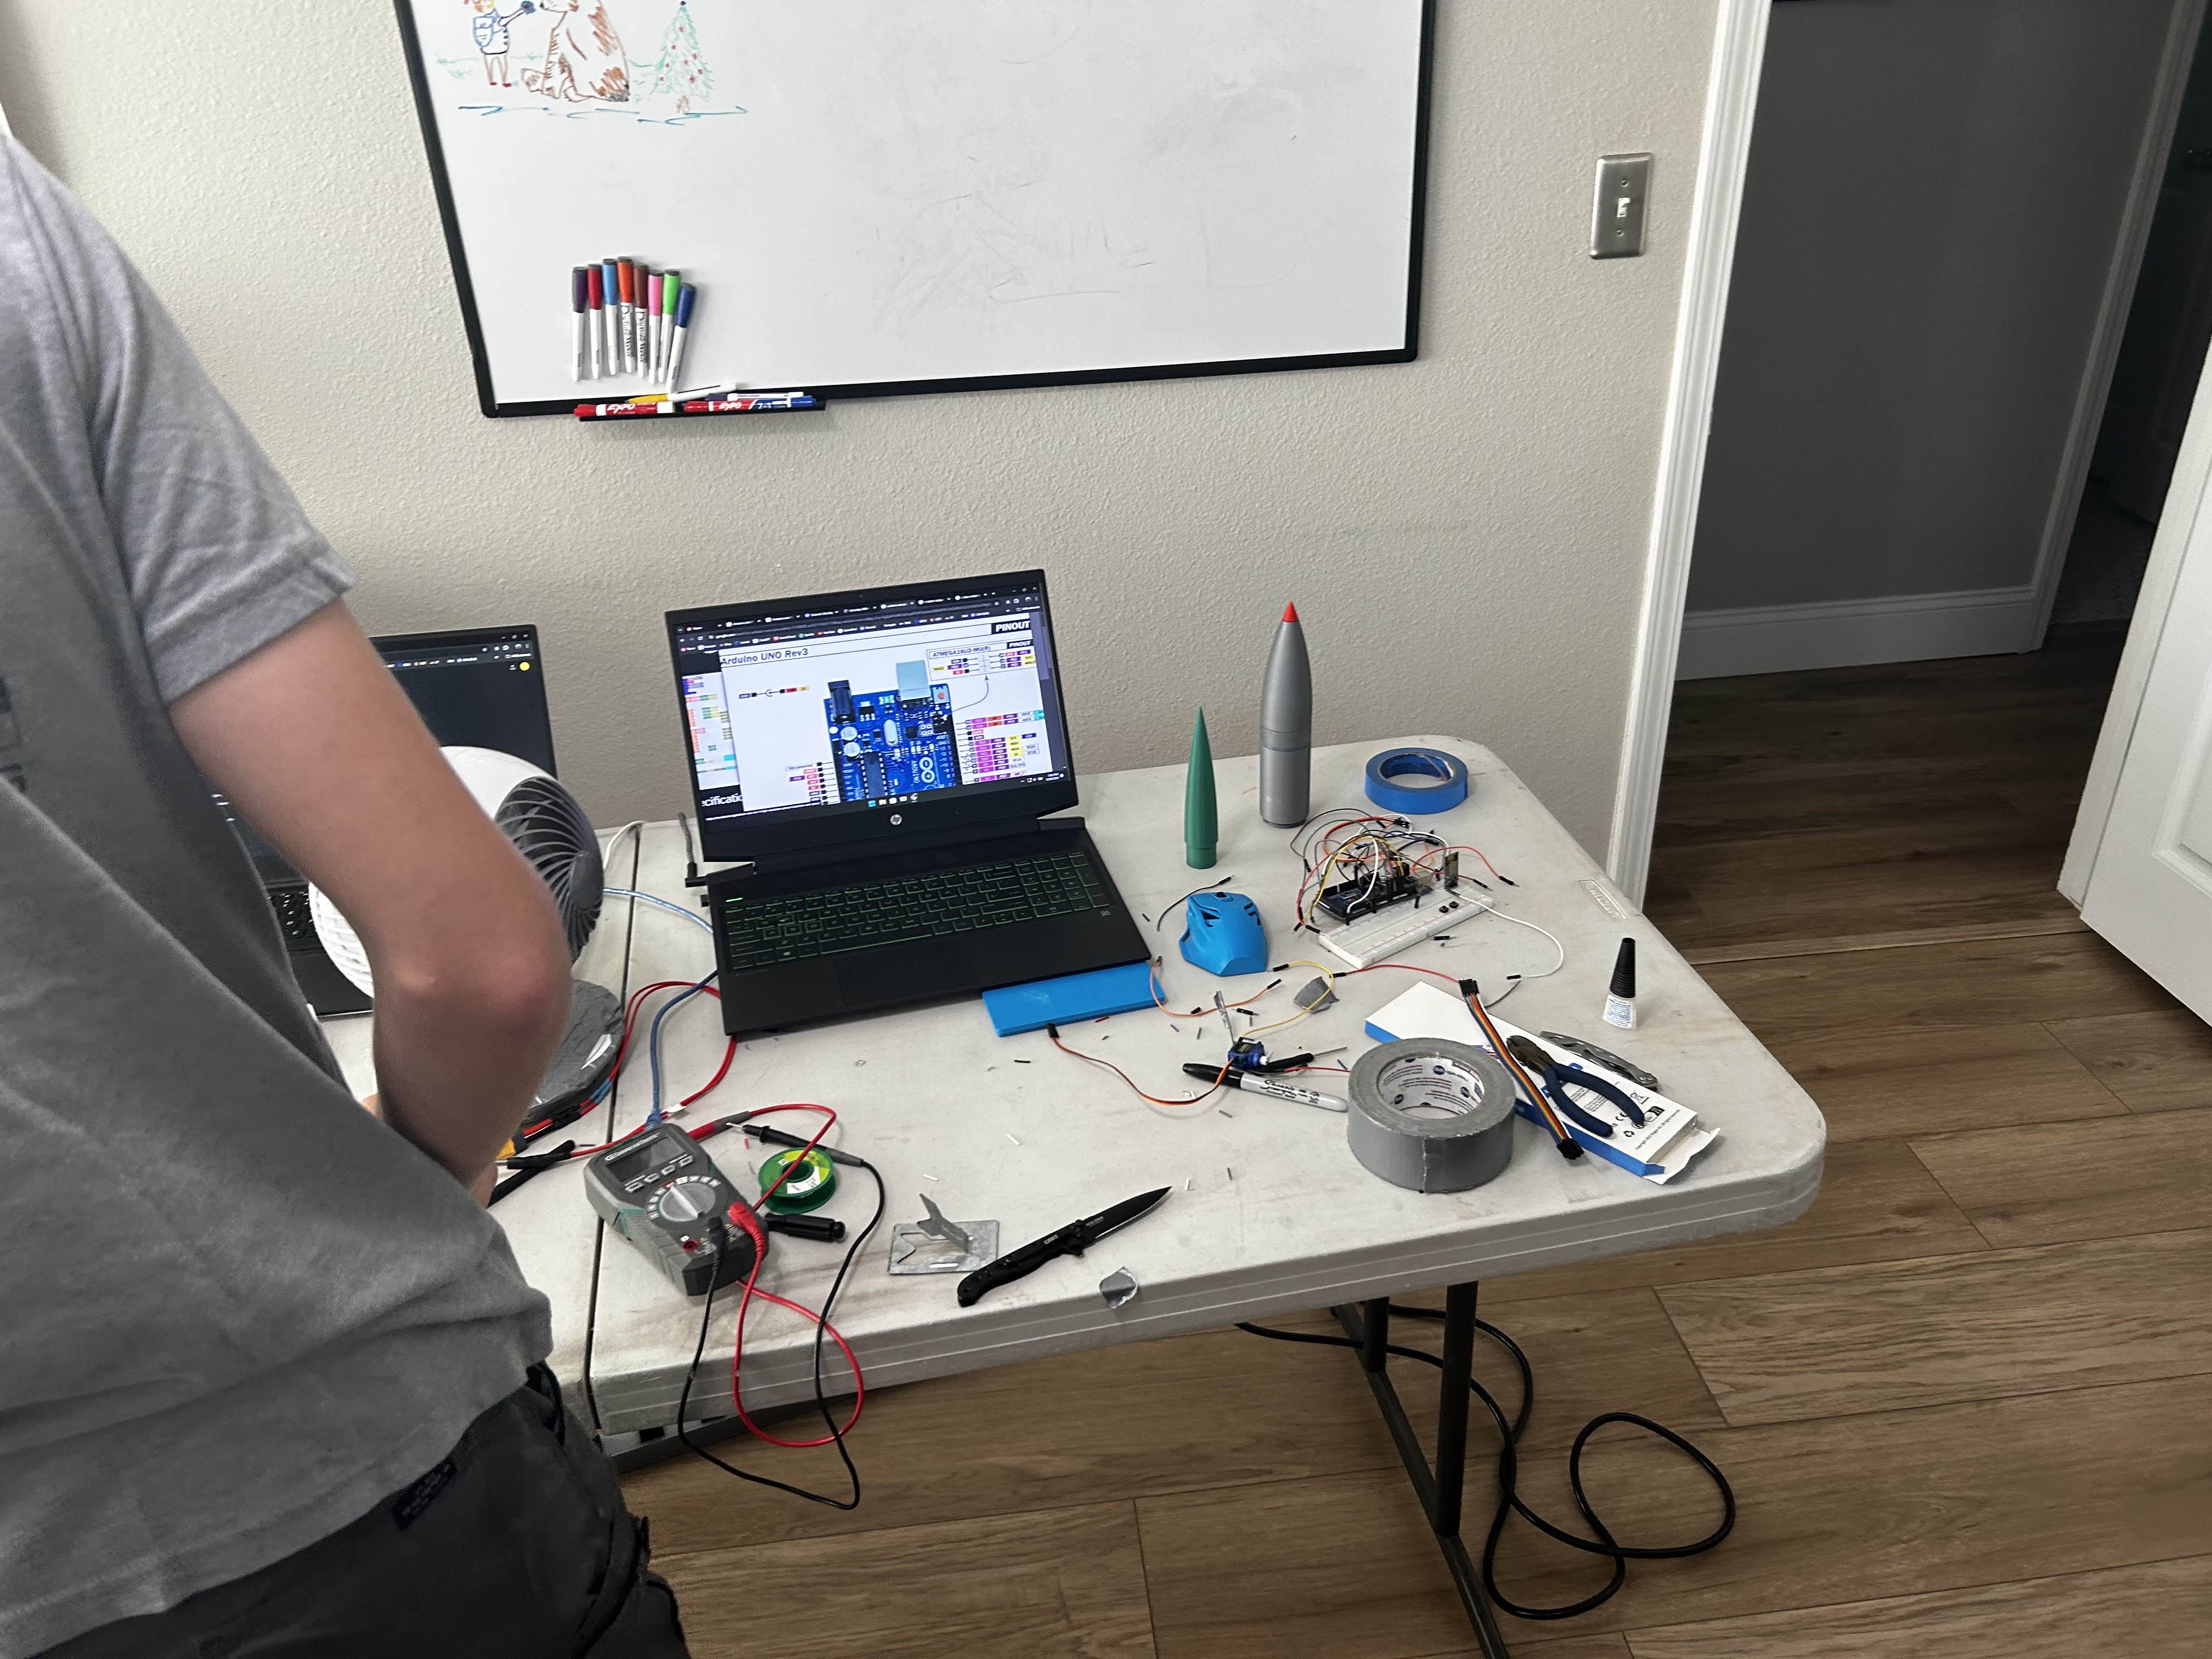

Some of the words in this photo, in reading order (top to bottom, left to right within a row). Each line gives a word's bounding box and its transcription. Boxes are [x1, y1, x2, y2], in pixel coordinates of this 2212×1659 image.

[607, 403, 636, 414] EXPO
[995, 620, 1031, 633] PINOUT
[721, 654, 758, 665] Arduino
[761, 651, 782, 661] UNO
[785, 648, 809, 657] Rev3
